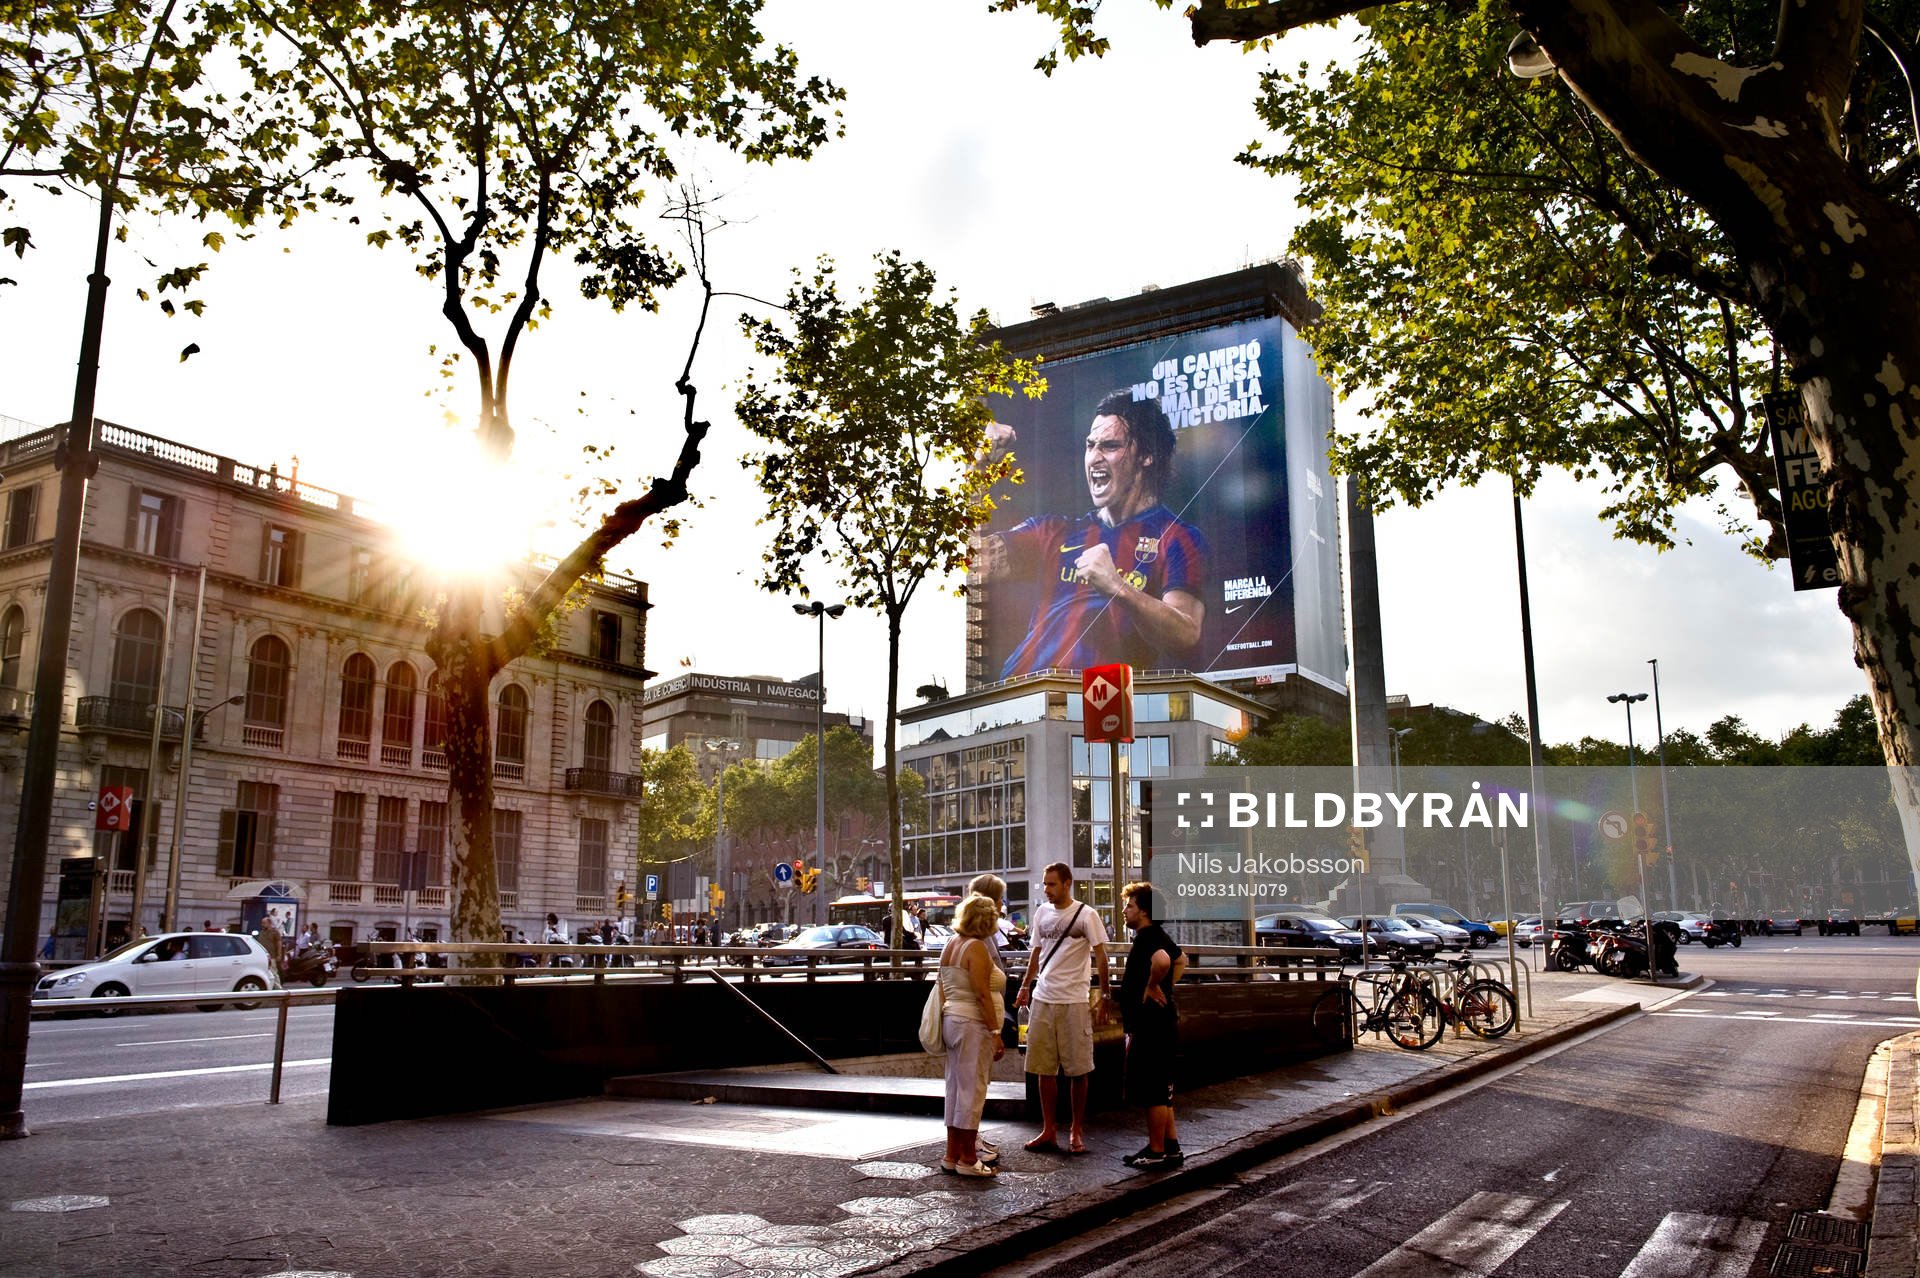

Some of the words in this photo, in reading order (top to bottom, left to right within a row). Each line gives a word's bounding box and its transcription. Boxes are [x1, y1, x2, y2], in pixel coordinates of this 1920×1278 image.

[1152, 358, 1178, 380] UN
[1182, 338, 1261, 374] CAMPIÓ
[1132, 380, 1159, 402] NO
[1163, 374, 1189, 397] ES
[1193, 359, 1262, 390] CANSA
[1161, 389, 1198, 414] MAI
[1204, 383, 1231, 406] DE
[1236, 378, 1263, 400] LA
[1224, 576, 1254, 591] MARCA
[1255, 575, 1267, 587] LA
[653, 688, 662, 698] DE
[691, 676, 751, 693] INDÚSTRIA
[757, 683, 761, 694] I
[767, 684, 828, 701] NAVEGACI
[1092, 683, 1107, 702] M
[648, 878, 655, 890] P
